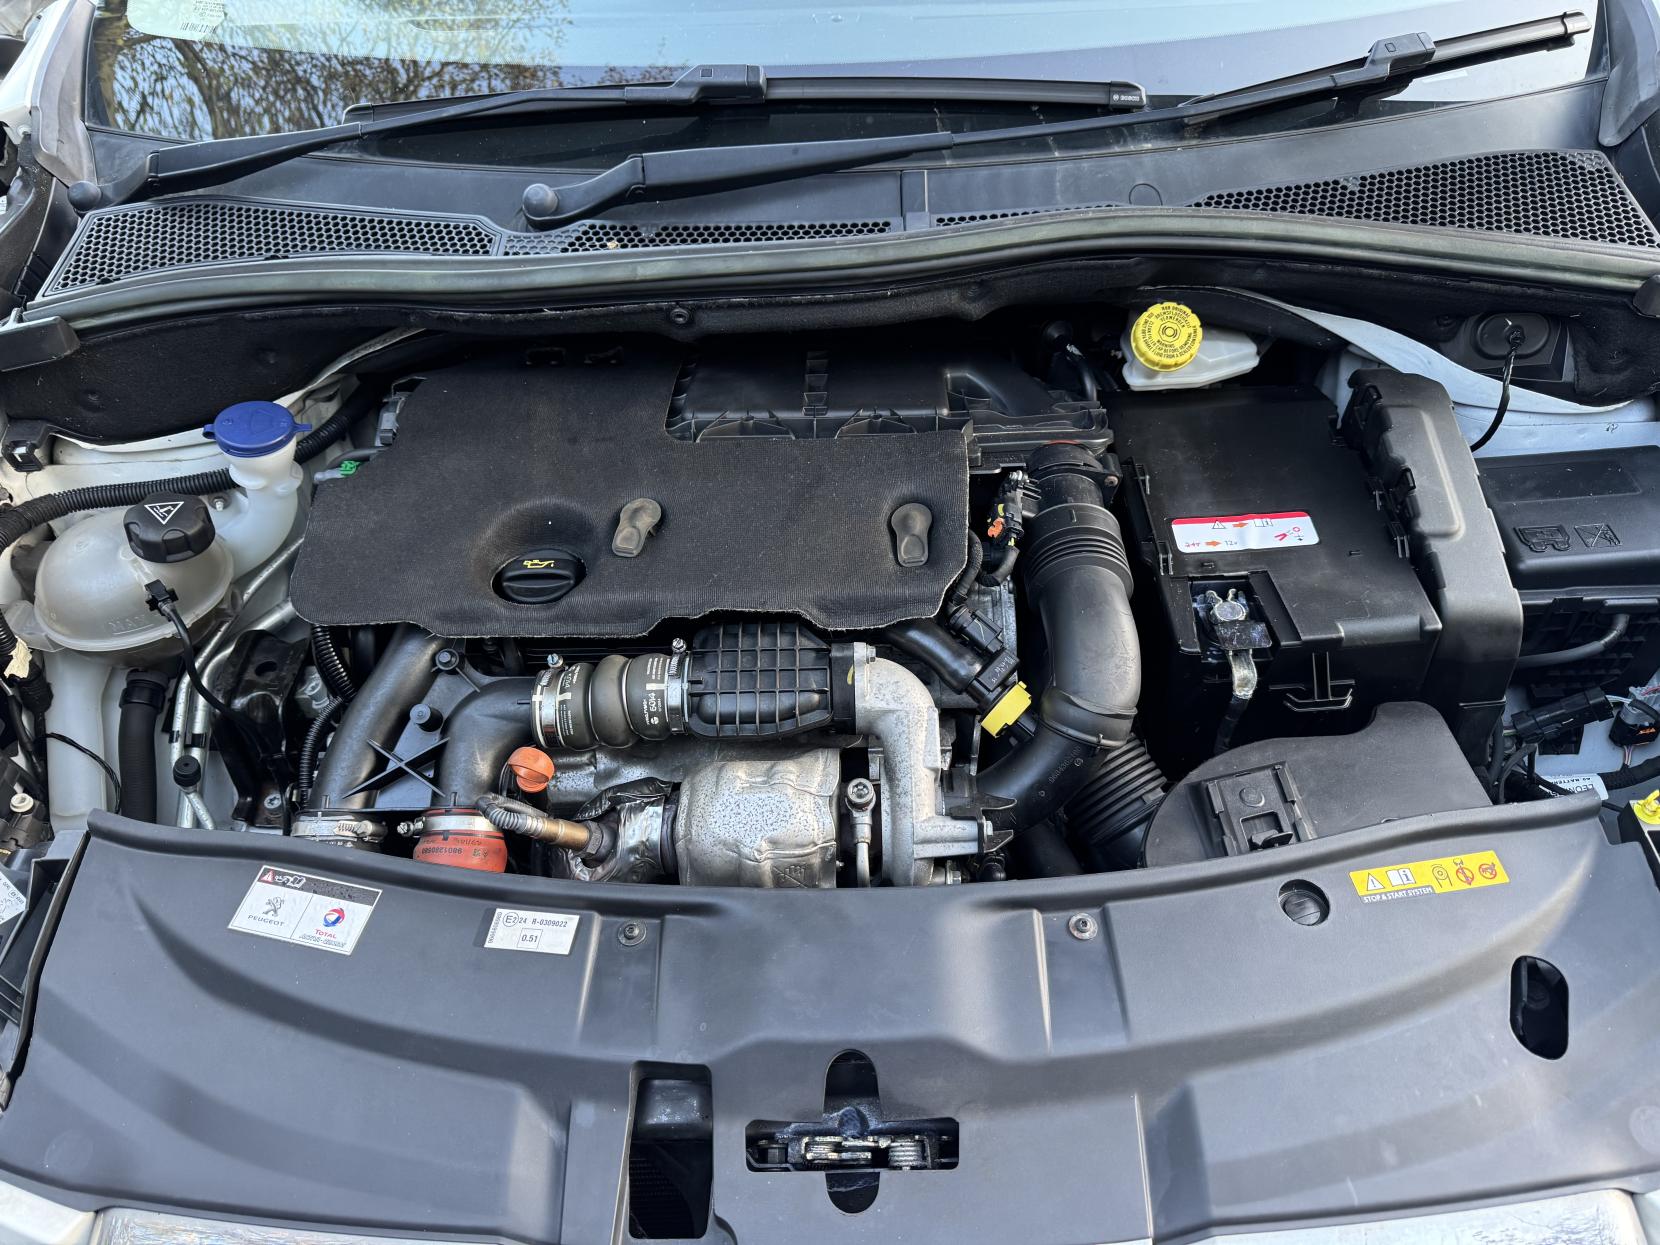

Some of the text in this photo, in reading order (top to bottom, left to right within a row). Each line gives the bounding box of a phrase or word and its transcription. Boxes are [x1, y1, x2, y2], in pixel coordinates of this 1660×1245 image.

[1363, 895, 1380, 903] STOP
[1388, 891, 1407, 899] START
[1408, 887, 1433, 896] SYSTEM
[247, 914, 285, 927] PEUGEOT
[505, 915, 517, 923] E2
[315, 929, 337, 939] TOTAL
[521, 934, 538, 943] 0.51
